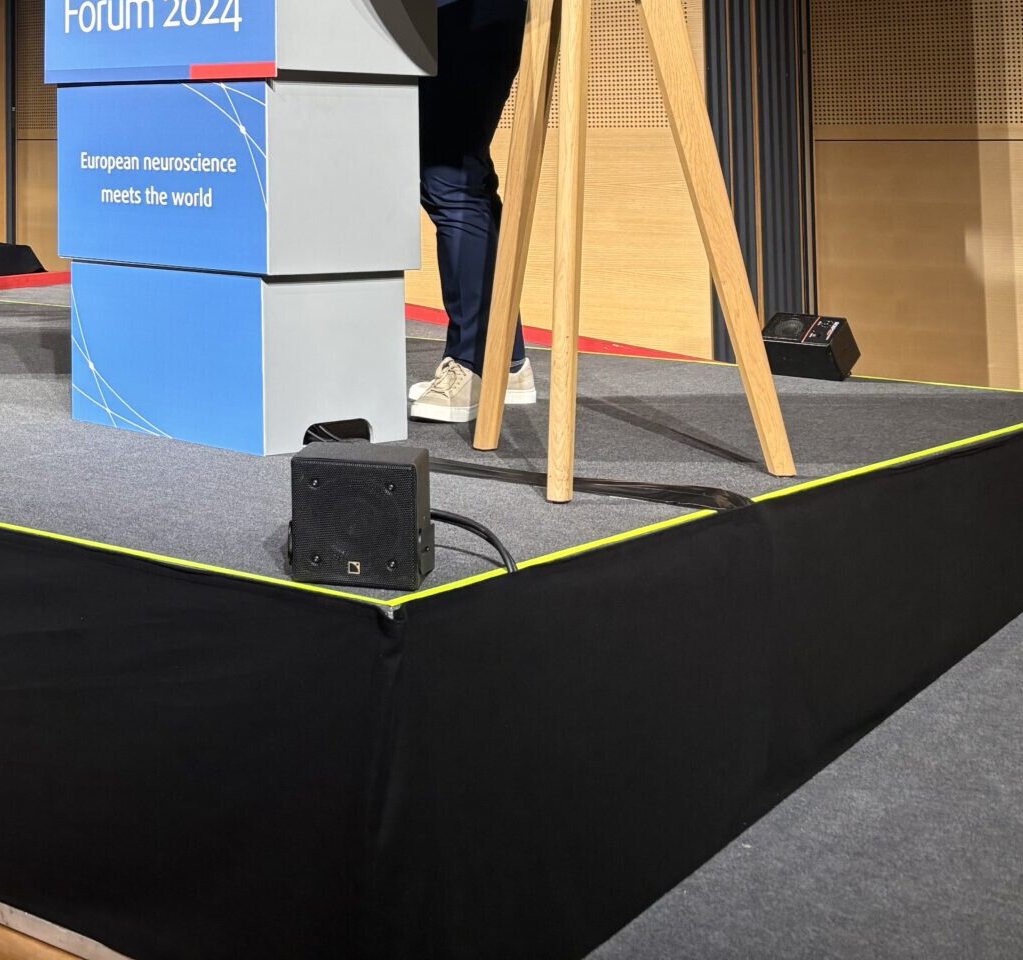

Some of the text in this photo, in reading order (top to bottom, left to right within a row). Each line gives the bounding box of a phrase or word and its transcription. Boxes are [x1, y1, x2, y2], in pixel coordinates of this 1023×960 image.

[80, 151, 237, 174] European neuroscience
[101, 185, 213, 208] meets the world
